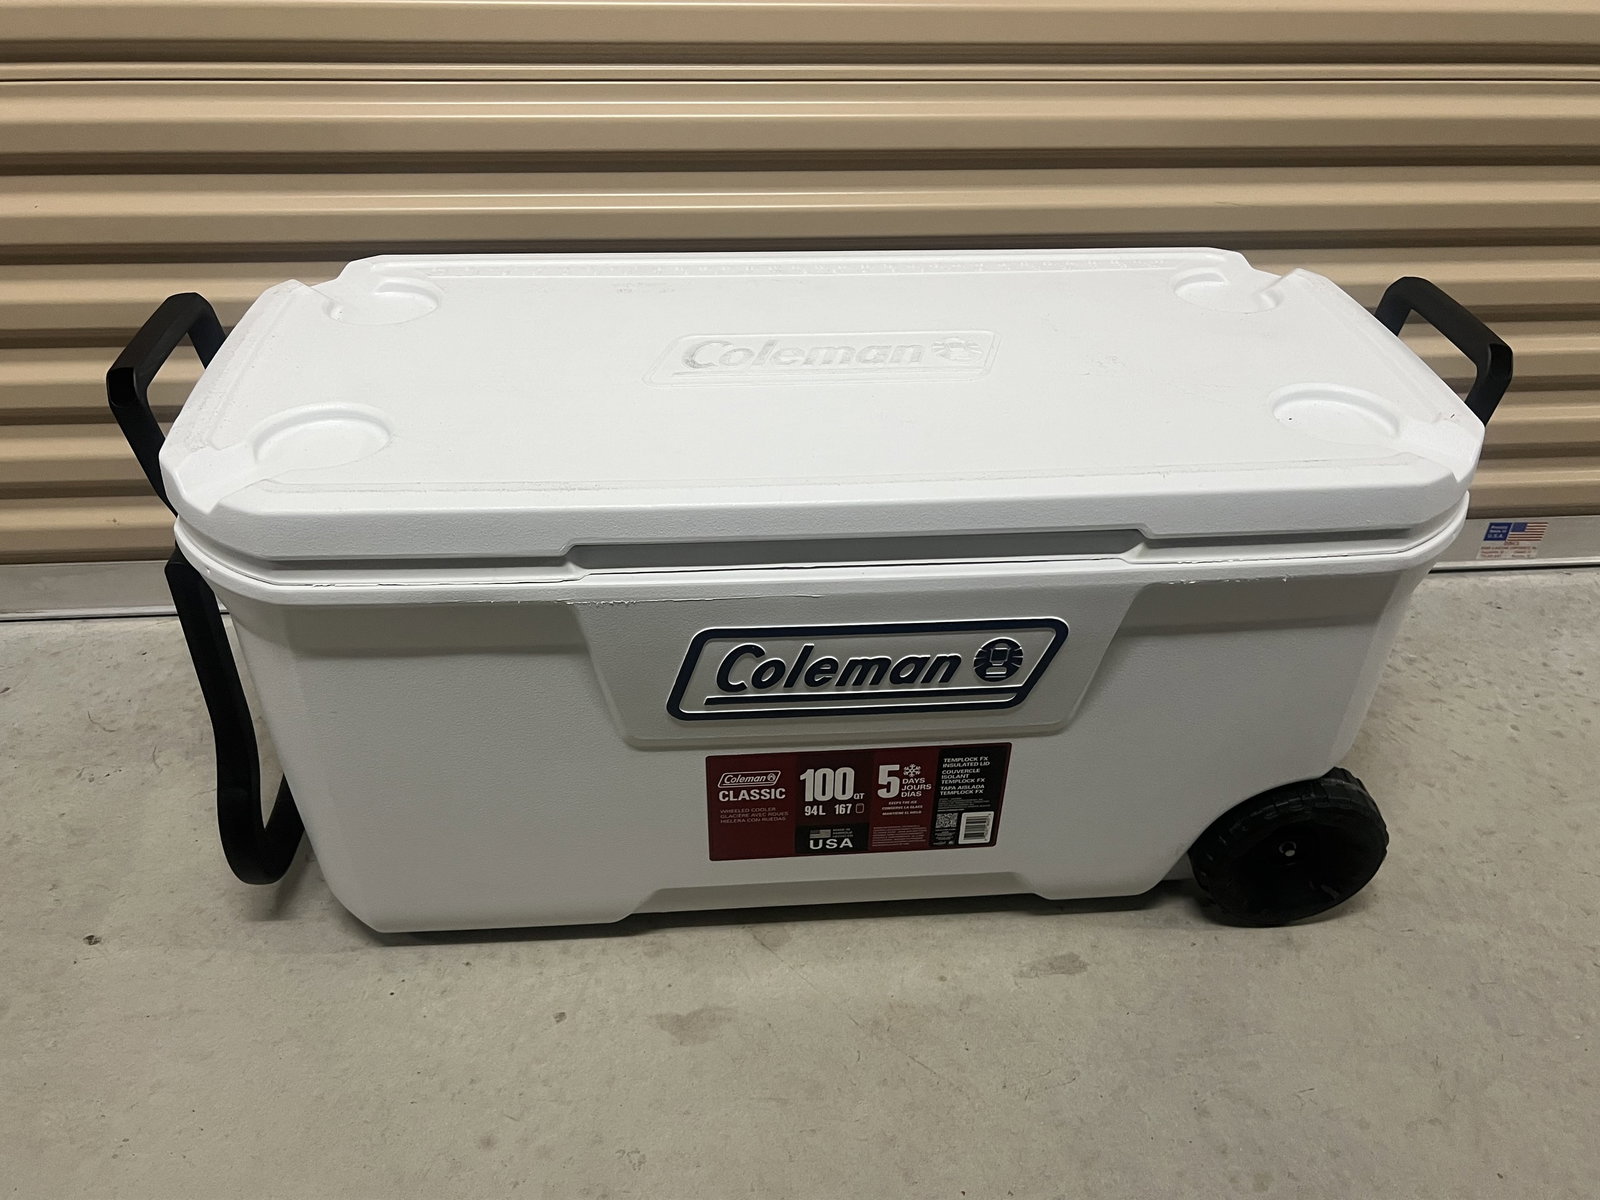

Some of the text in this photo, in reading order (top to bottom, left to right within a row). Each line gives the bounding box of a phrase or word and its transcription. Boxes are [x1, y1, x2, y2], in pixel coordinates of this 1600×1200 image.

[683, 339, 923, 369] Coleman
[717, 643, 962, 693] Coleman
[724, 774, 766, 784] Coleman
[800, 766, 854, 802] 100
[878, 764, 900, 798] 5
[718, 788, 786, 802] CLASSIC
[834, 804, 852, 814] 167
[809, 838, 853, 849] USA
